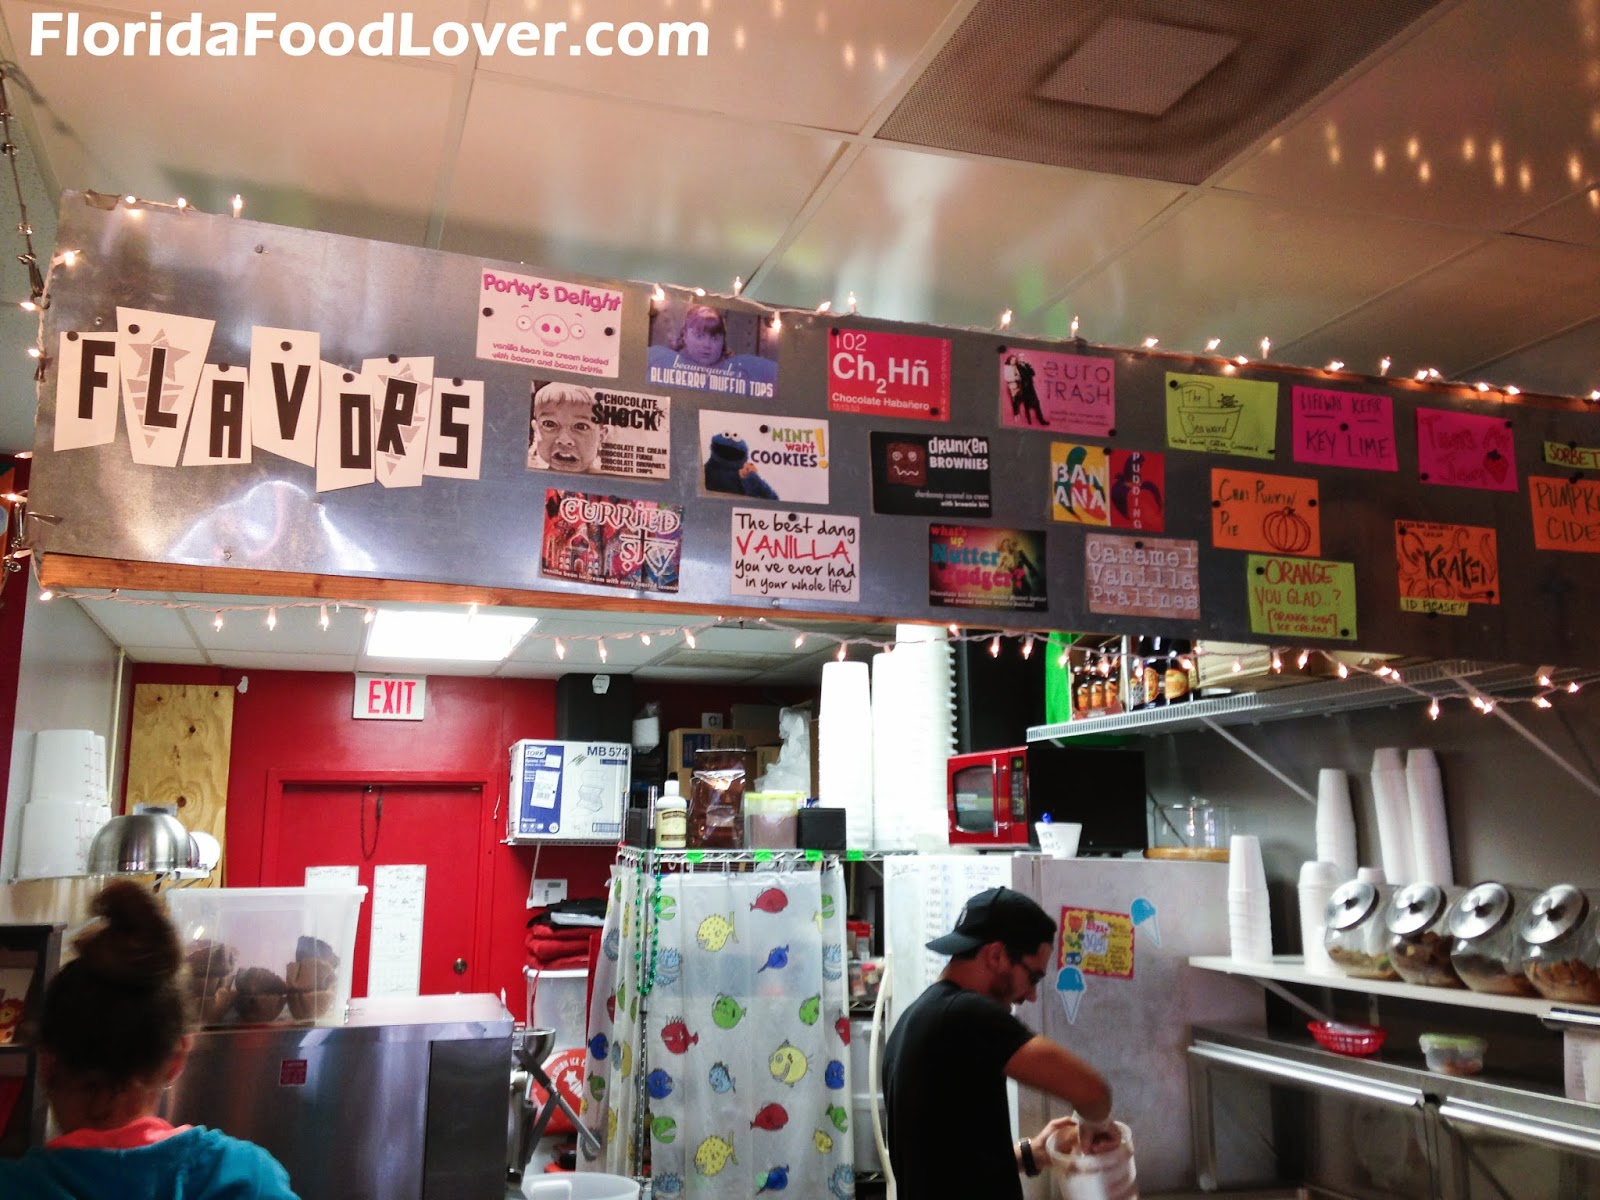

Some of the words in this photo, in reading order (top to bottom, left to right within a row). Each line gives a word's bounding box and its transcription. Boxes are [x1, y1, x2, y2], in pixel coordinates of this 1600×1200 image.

[484, 273, 549, 302] Porky's
[554, 286, 621, 313] Delight
[492, 352, 509, 361] with
[511, 354, 535, 364] bacon
[537, 357, 553, 367] and
[554, 360, 578, 371] bacon
[579, 362, 604, 374] brittle
[493, 343, 518, 352] vanilla
[520, 346, 541, 356] bean
[543, 349, 554, 358] ice
[555, 351, 582, 361] cream
[582, 354, 609, 365] loaded
[650, 366, 707, 389] BLUEBERRY
[709, 374, 747, 394] MUFFIN
[749, 381, 774, 398] TOPS
[1043, 360, 1110, 384] euro
[78, 338, 471, 469] FLAVORS
[604, 393, 658, 411] CHOCOLATE
[832, 392, 881, 406] Chocolate
[884, 397, 930, 410] Habañero
[1044, 379, 1110, 405] TRASH
[771, 427, 813, 443] MINT
[785, 441, 815, 453] want
[1306, 429, 1337, 460] KEY
[1347, 434, 1391, 460] LIME
[600, 449, 634, 459] CHOCOLATE
[636, 453, 653, 461] FUDGE
[601, 442, 634, 452] CHOCOLATE
[647, 447, 667, 455] CREAM
[751, 450, 817, 468] COOKIES
[600, 457, 634, 467] CHOCOLATE
[636, 461, 666, 470] BROWNIES
[600, 464, 634, 473] CHOCOLATE
[929, 456, 989, 470] BROWNIES
[1132, 451, 1143, 529] PUDDING
[735, 513, 770, 531] The
[774, 513, 814, 534] best
[817, 519, 857, 544] dang
[736, 530, 851, 564] VANILLA
[950, 537, 965, 548] up
[1088, 541, 1198, 568] Caramel
[735, 555, 784, 579] you've
[788, 562, 823, 576] ever
[827, 562, 856, 578] had
[931, 543, 1000, 567] Nutter
[1089, 562, 1198, 590] Vanilla
[1265, 558, 1338, 586] ORANGE
[745, 575, 756, 588] in
[760, 577, 788, 594] your
[792, 577, 826, 591] whole
[1090, 585, 1198, 609] Pralines
[1254, 586, 1281, 616] YOU
[367, 680, 417, 715] EXIT
[587, 746, 607, 756] MB
[608, 747, 630, 757] 574
